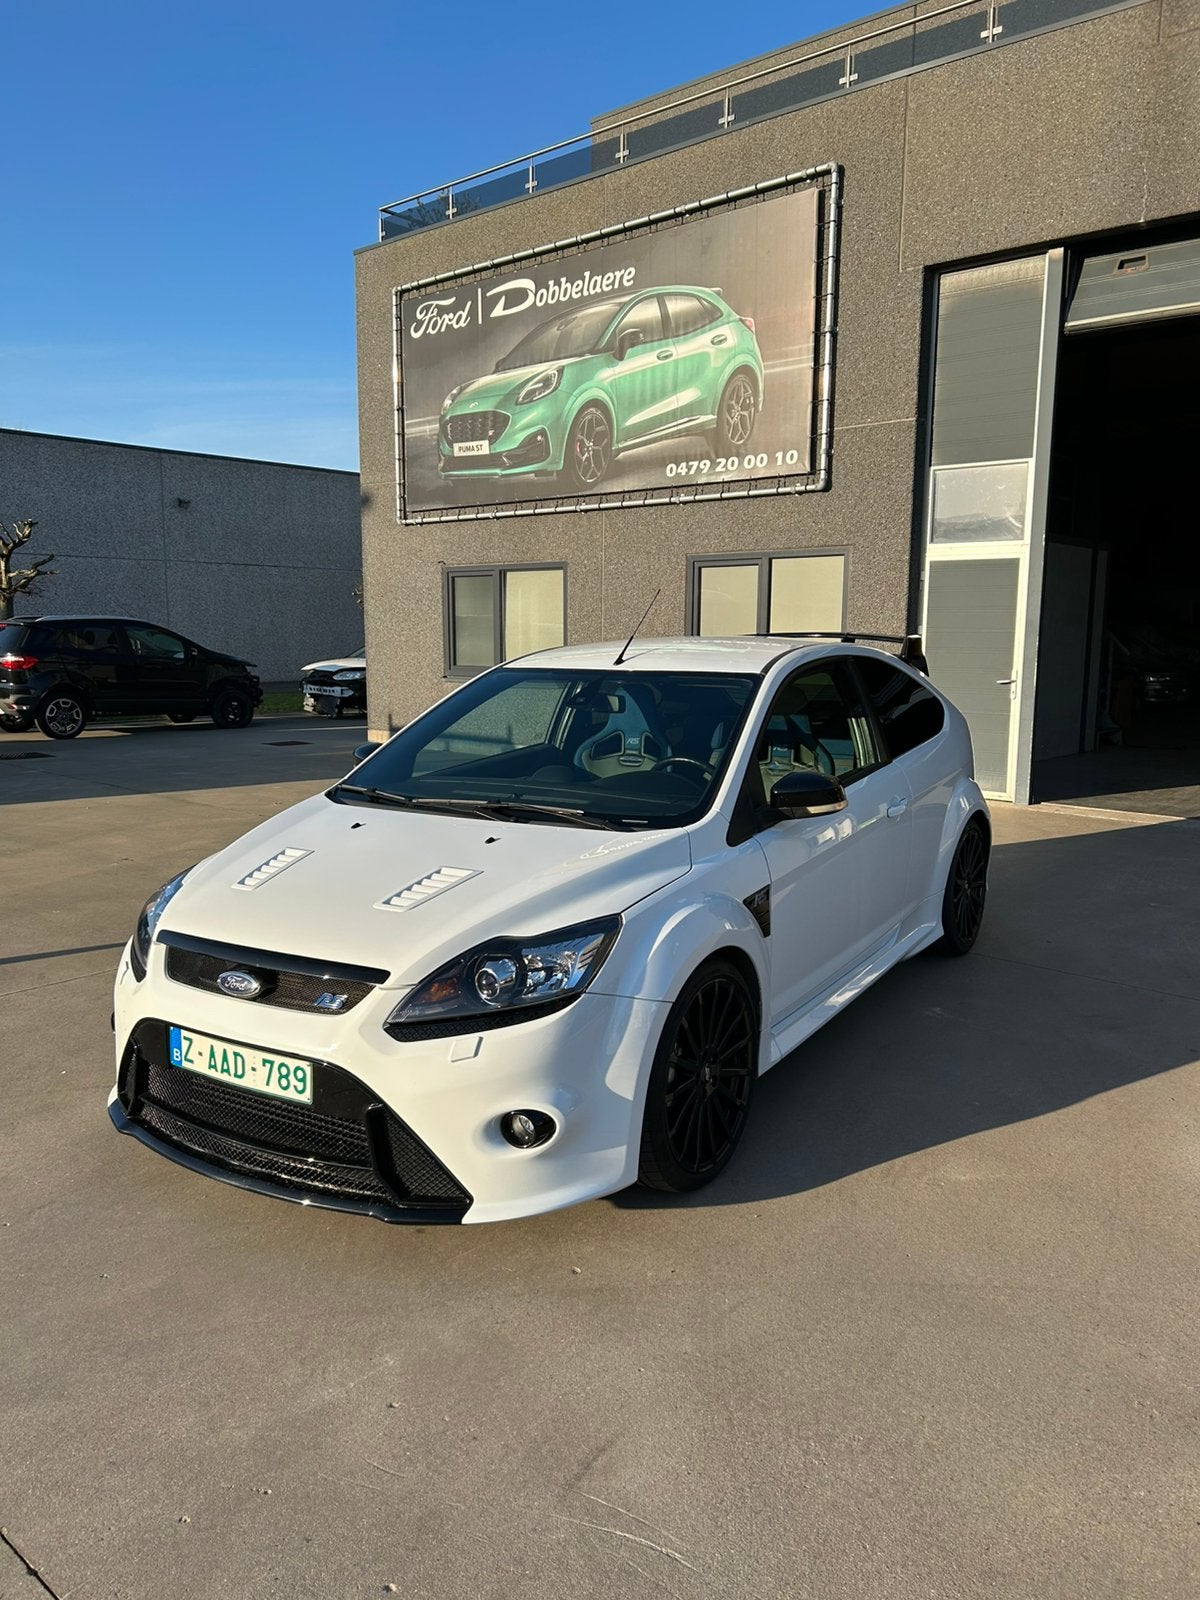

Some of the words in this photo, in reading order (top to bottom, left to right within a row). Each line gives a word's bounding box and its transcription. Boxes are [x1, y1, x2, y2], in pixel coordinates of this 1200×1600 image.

[410, 296, 472, 339] Ford
[486, 266, 636, 318] Dobbelaere
[458, 445, 475, 454] PUMA
[476, 444, 483, 452] ST
[666, 459, 711, 477] 0479
[715, 456, 739, 472] 20
[743, 453, 768, 469] 00
[775, 449, 798, 465] 10
[224, 976, 247, 991] Ford
[314, 992, 349, 1009] RS
[173, 1048, 181, 1061] B
[183, 1035, 307, 1095] Z-AAD-789
